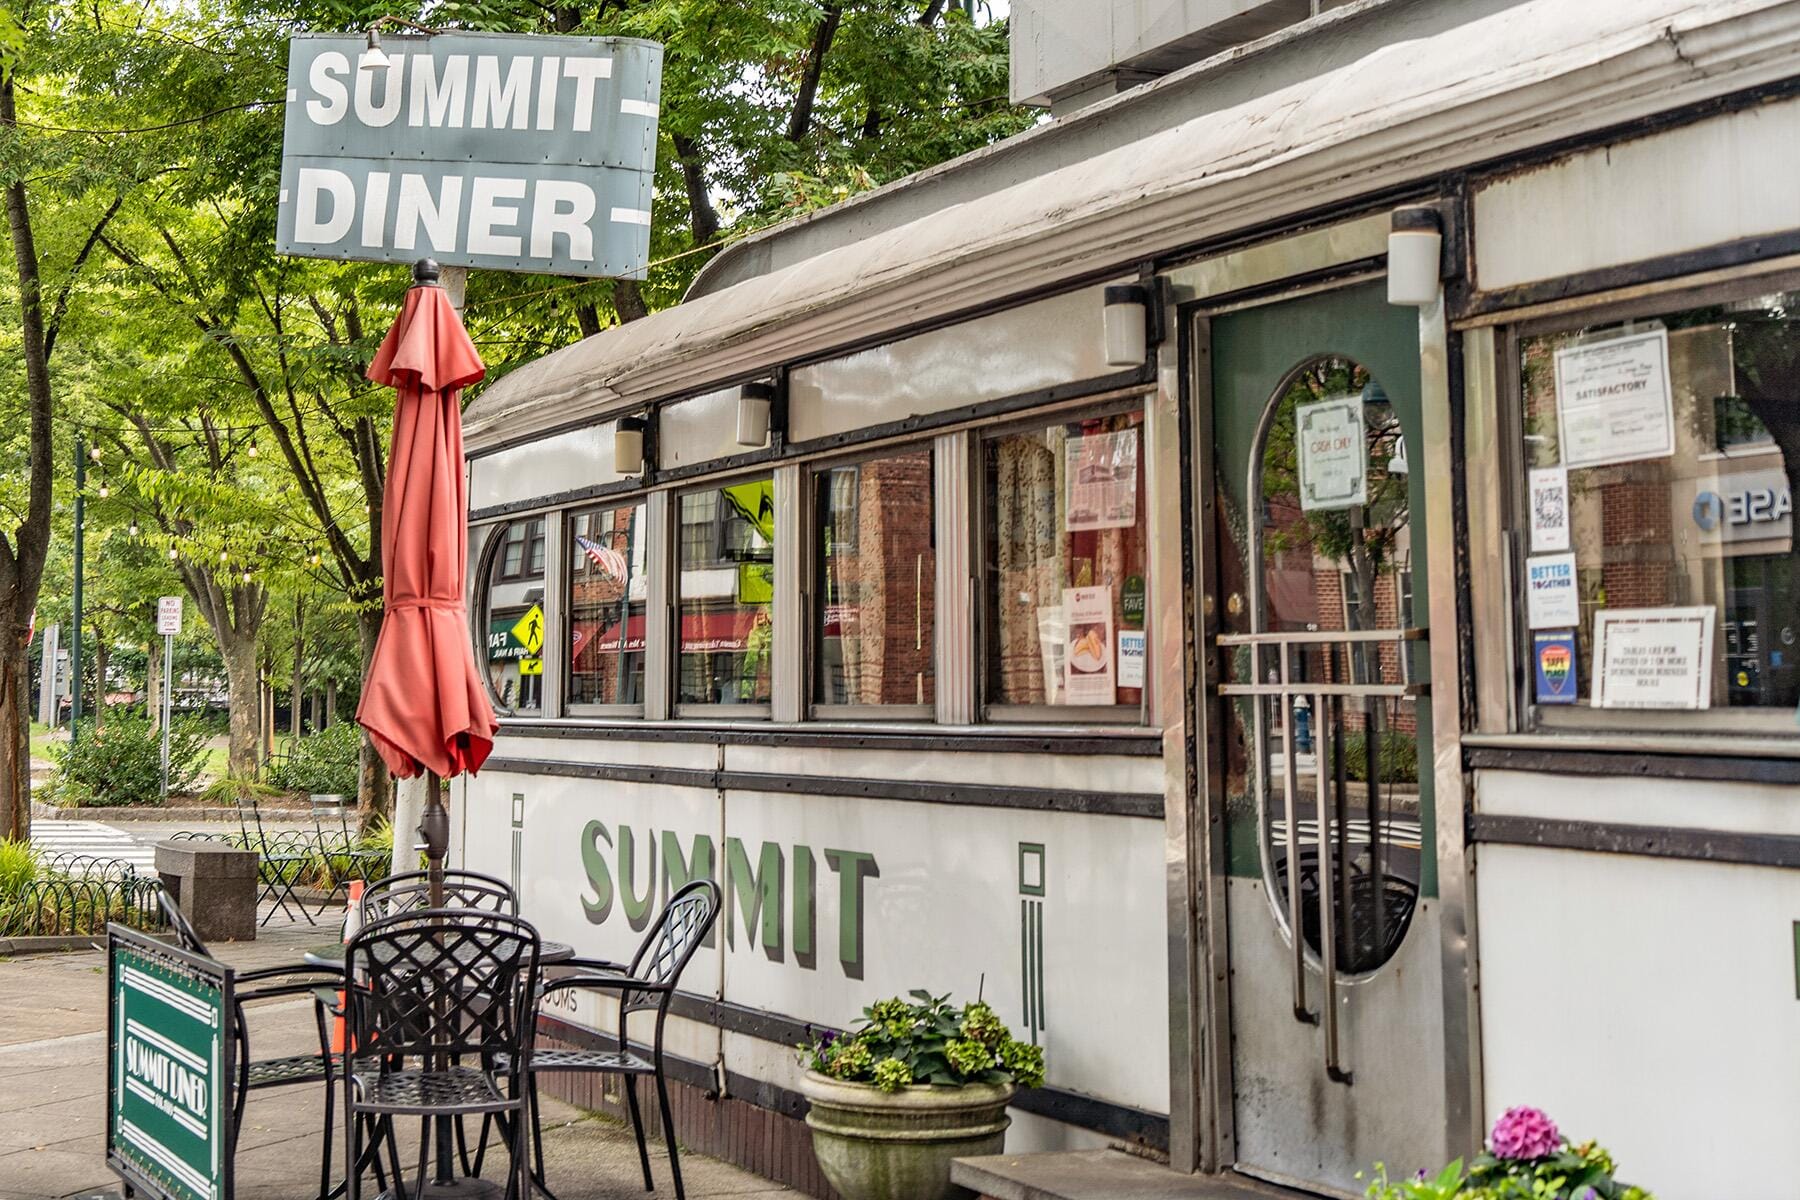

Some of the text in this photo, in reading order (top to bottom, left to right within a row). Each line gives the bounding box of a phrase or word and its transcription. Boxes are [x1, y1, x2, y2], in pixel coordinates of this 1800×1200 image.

[306, 51, 613, 132] SUMMIT
[294, 167, 597, 262] DINER
[1576, 380, 1647, 401] SATISFACTORY
[1531, 564, 1570, 580] BETTER
[1532, 578, 1571, 590] TOGETHER
[1124, 598, 1144, 611] FAVE
[580, 819, 880, 981] SUMMIT
[127, 1036, 170, 1093] SUMMIT
